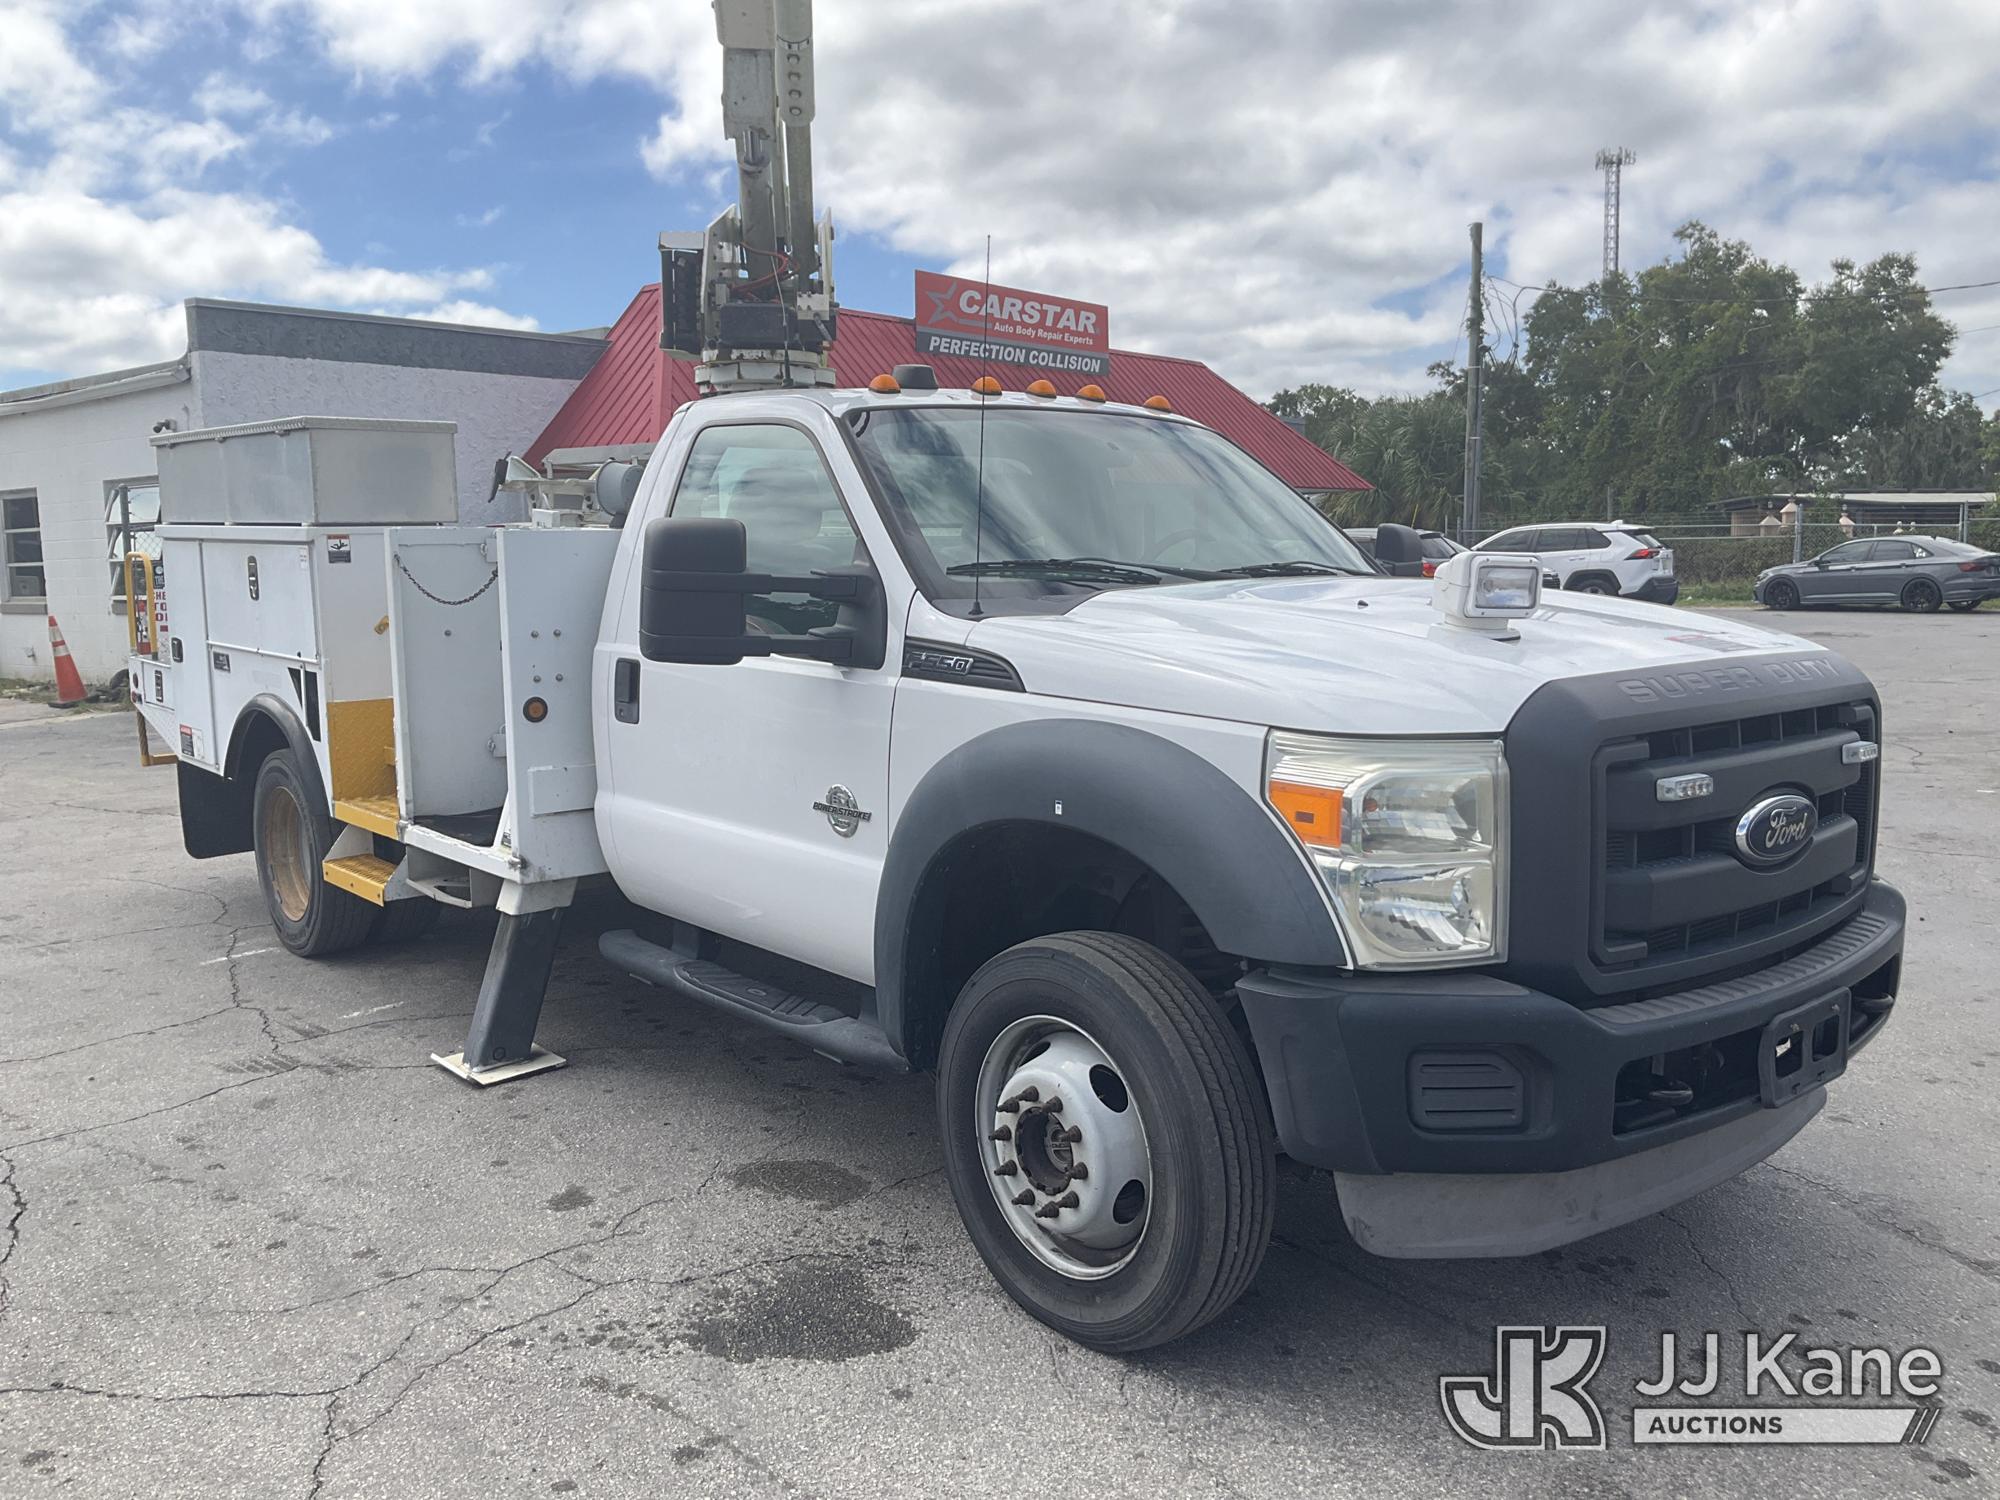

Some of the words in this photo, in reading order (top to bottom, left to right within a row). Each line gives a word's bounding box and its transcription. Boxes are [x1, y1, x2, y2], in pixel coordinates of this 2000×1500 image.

[959, 289, 1097, 334] CARSTAR
[929, 336, 1026, 363] PERFECTION
[1028, 351, 1101, 373] COLLISION
[994, 322, 1014, 333] Auto
[1016, 325, 1036, 338] Body
[1037, 328, 1063, 343] Repair
[1064, 333, 1093, 346] Experts
[1616, 666, 1763, 703] SUPER
[1764, 657, 1841, 684] DUTY
[1765, 806, 1808, 849] Ford
